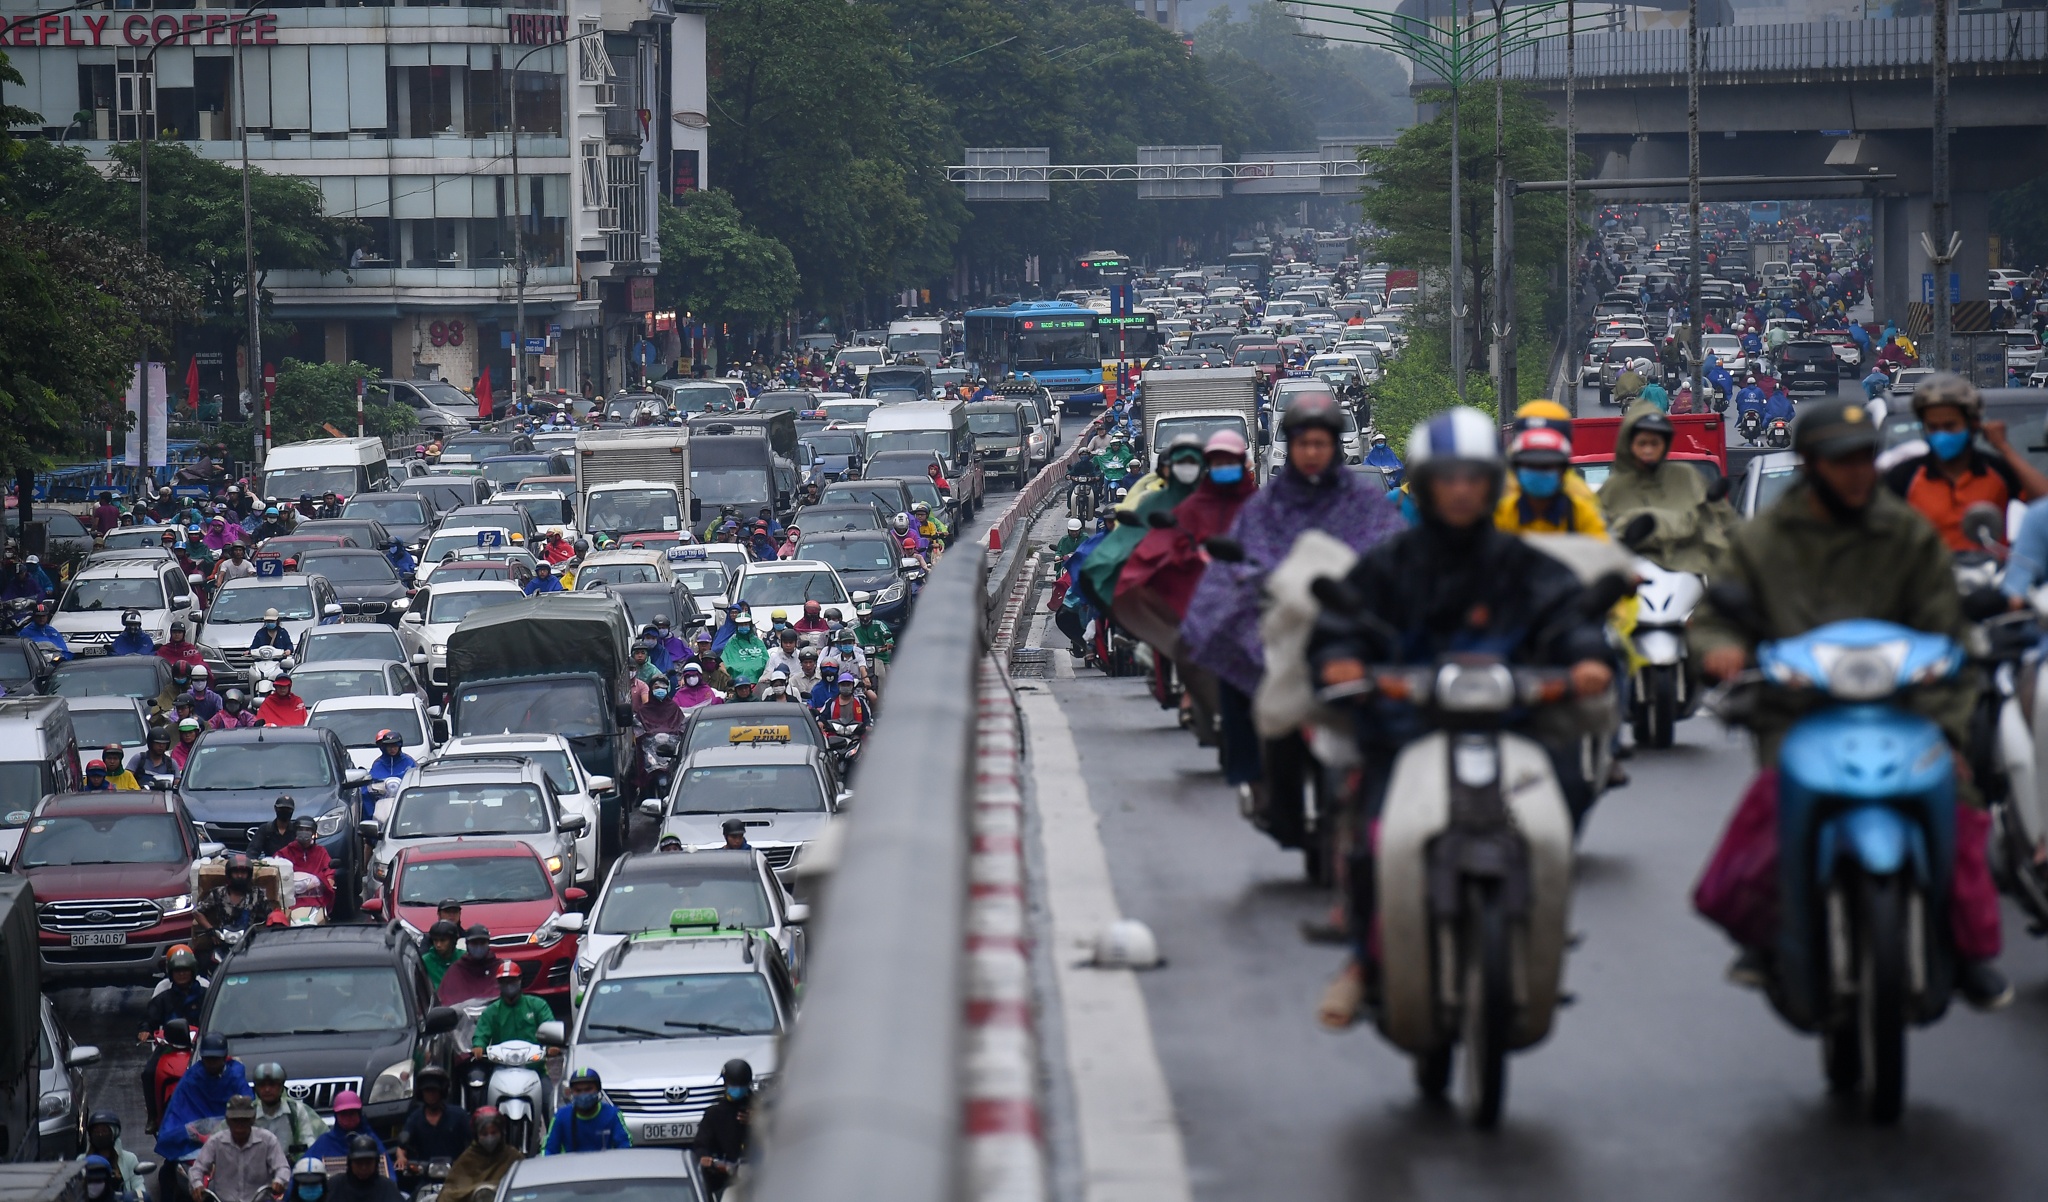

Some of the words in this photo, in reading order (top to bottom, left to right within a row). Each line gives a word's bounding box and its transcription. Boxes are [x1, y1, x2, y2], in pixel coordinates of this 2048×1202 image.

[123, 14, 278, 46] COFFEE
[508, 14, 569, 45] FIREFLY
[430, 320, 464, 347] 93
[262, 561, 276, 574] G7
[738, 646, 762, 656] Grab
[72, 933, 125, 946] 30F-340.67
